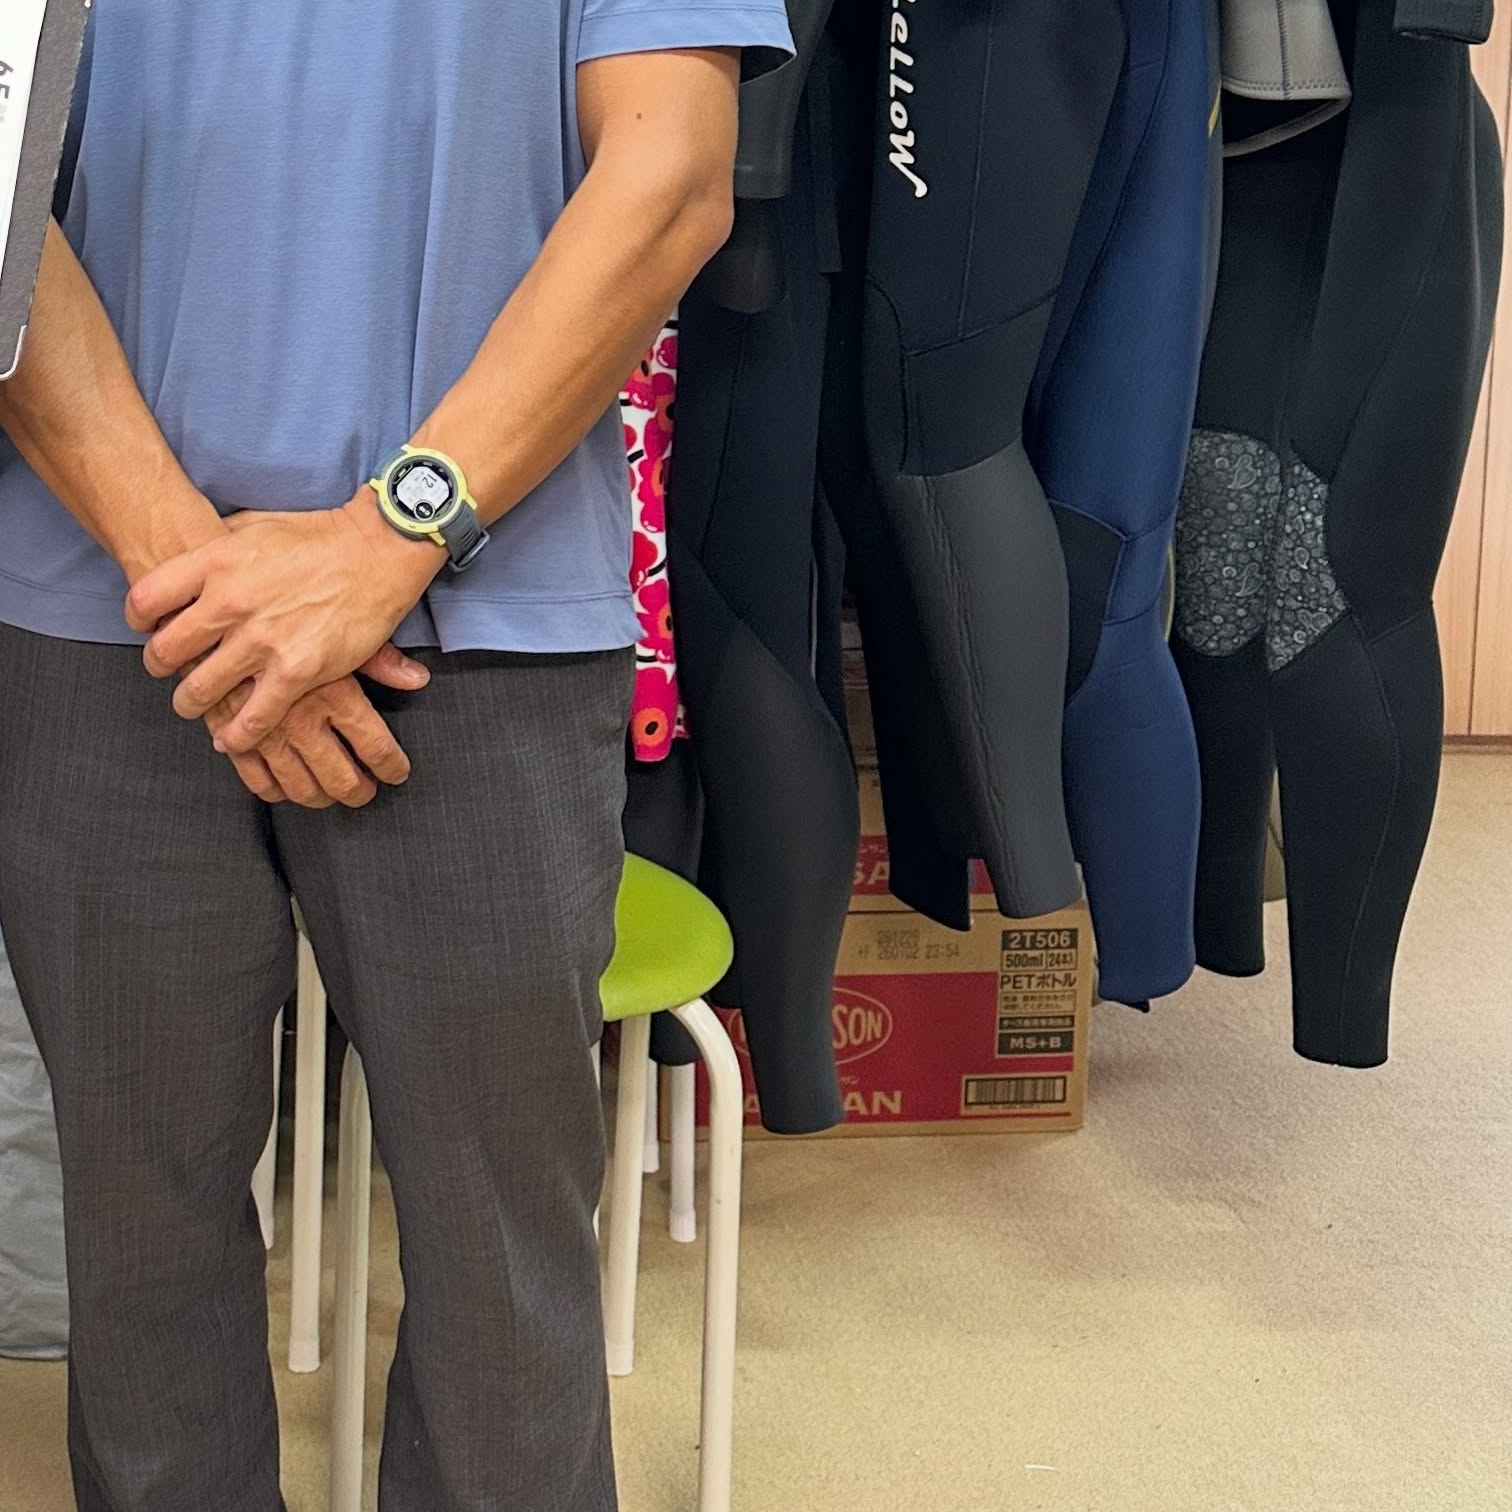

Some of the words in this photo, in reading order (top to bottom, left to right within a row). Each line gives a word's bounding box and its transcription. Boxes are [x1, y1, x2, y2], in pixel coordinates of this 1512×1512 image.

[1009, 931, 1071, 948] 2T506
[1005, 952, 1044, 969] 500ml
[1000, 972, 1077, 991] PETボトル
[832, 1011, 883, 1046] SON
[1009, 1035, 1062, 1050] MS+B
